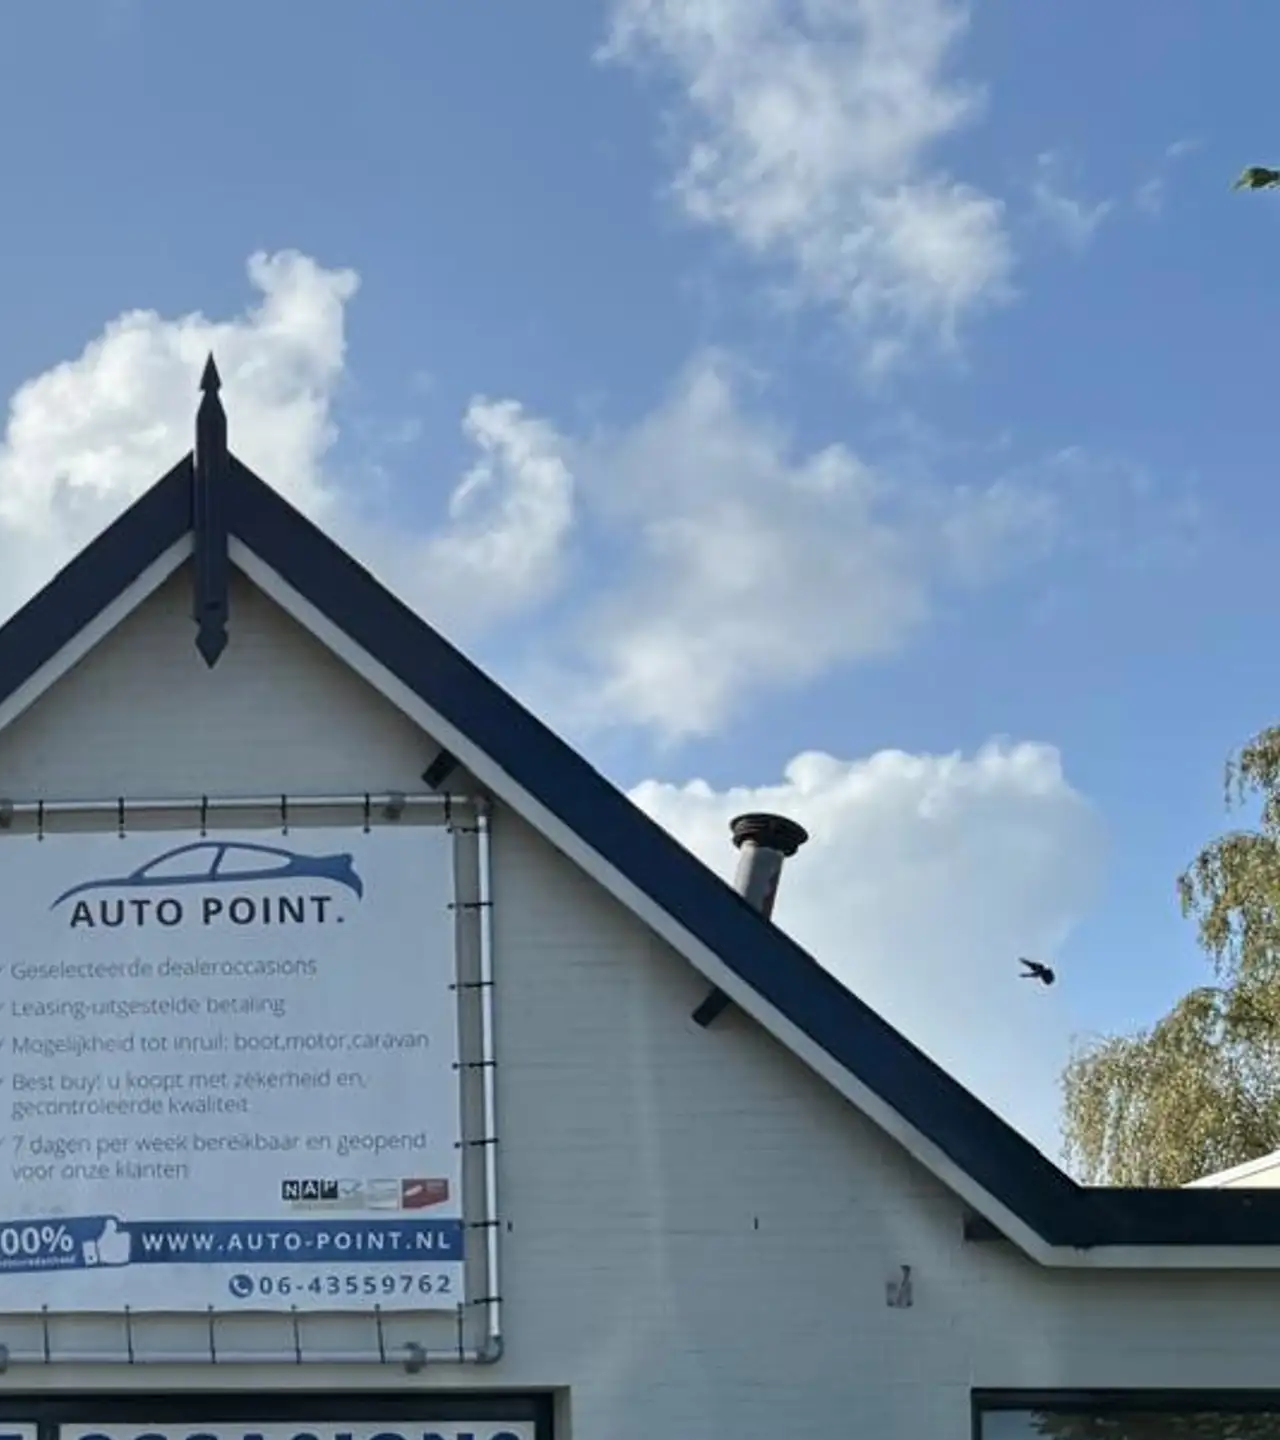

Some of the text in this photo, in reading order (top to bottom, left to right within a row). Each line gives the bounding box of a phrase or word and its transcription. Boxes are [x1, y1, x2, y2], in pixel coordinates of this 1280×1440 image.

[69, 898, 183, 928] AUTO
[10, 957, 318, 980] Geselecteerde dealeroccasions
[11, 1035, 134, 1057] Mogelijkheid
[141, 1035, 168, 1051] tot
[12, 1073, 55, 1091] Best
[108, 1075, 120, 1090] u
[126, 1070, 183, 1092] koopt
[189, 1073, 227, 1089] met
[233, 1069, 330, 1089] zekerheid
[11, 1095, 247, 1121] gecontroleerde kwaliteit
[12, 1132, 426, 1160] 7 dagen per week bereikbaar en geopend
[12, 1160, 189, 1180] voor onze klanten
[142, 1231, 451, 1251] WWW.AUTO-POINT.NL
[260, 1274, 452, 1295] 06-43559762
